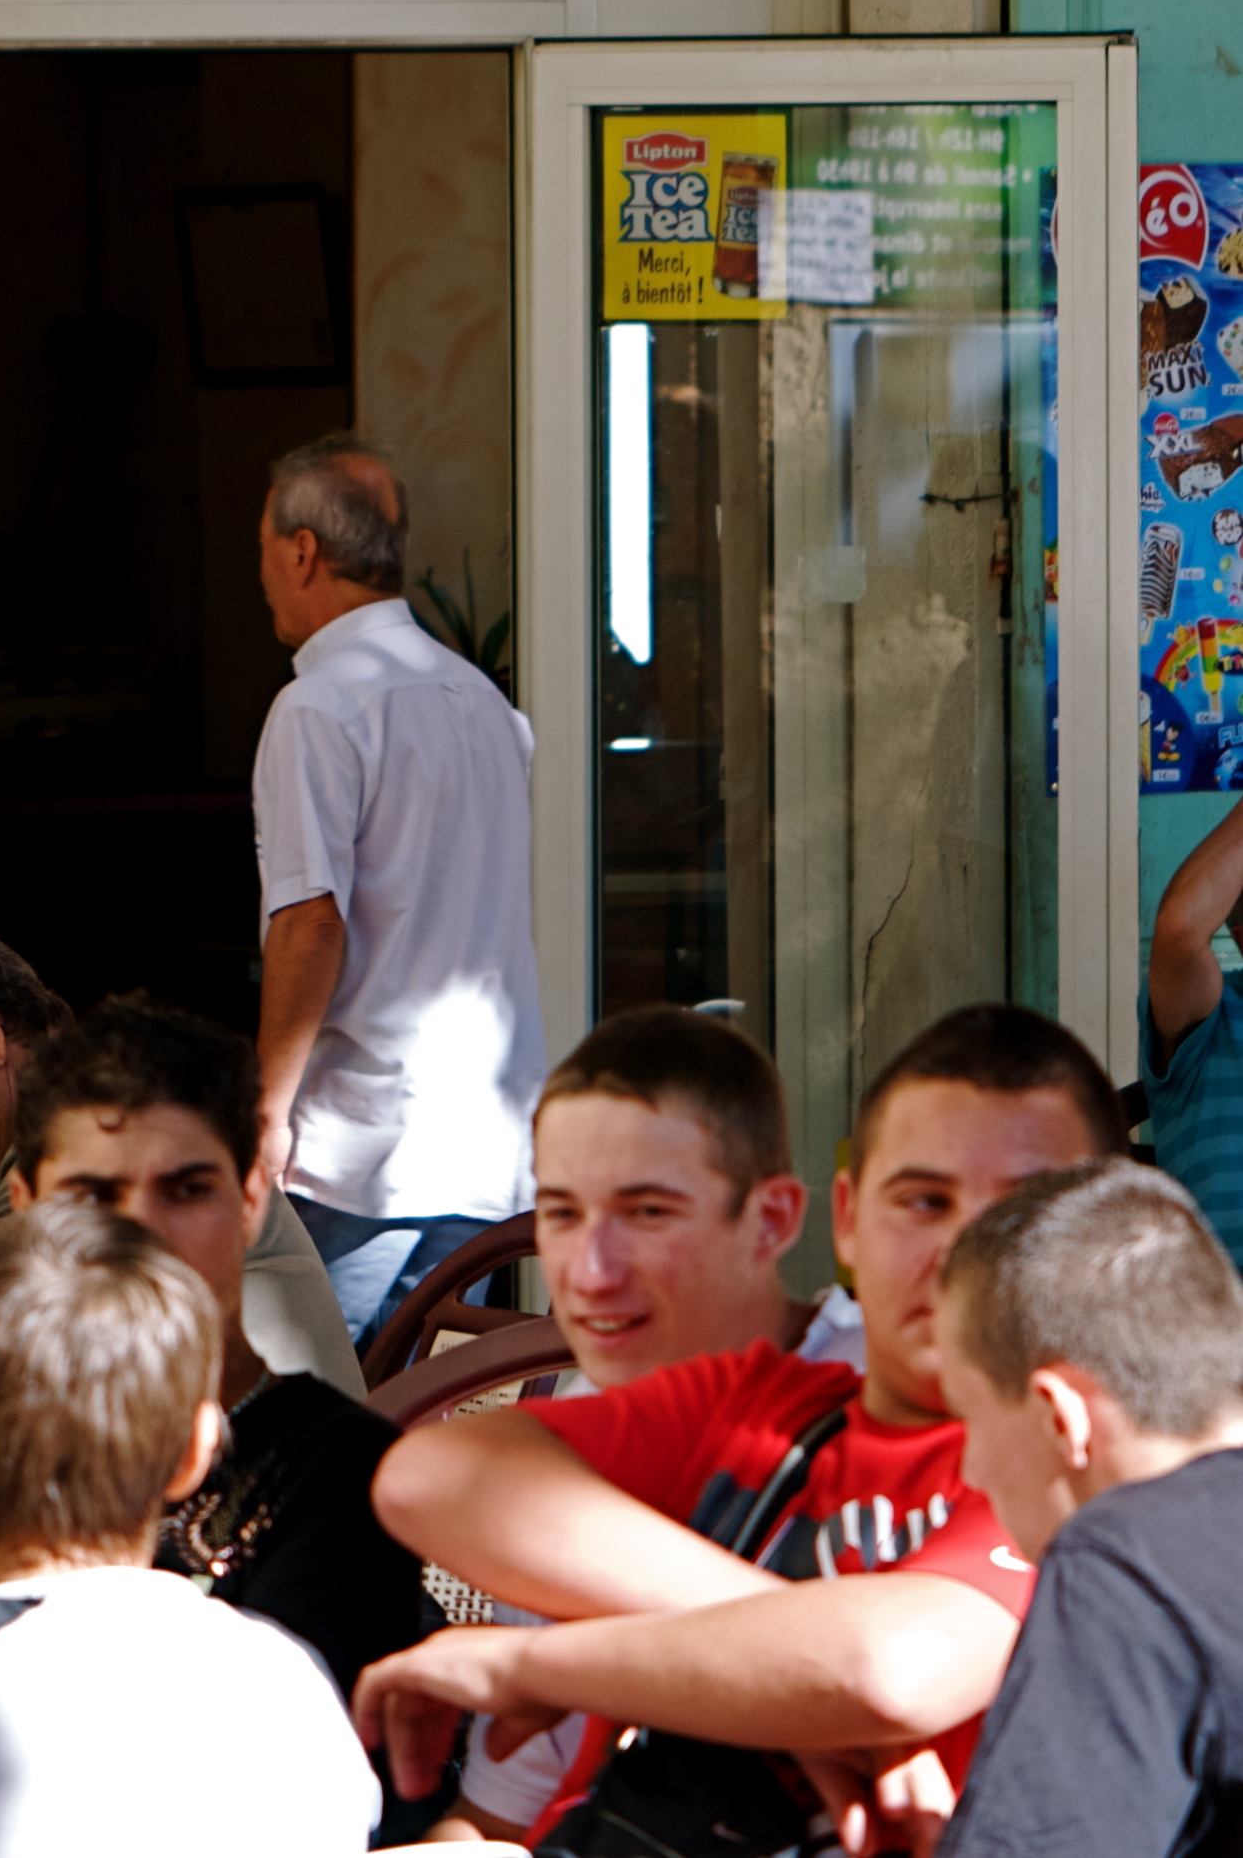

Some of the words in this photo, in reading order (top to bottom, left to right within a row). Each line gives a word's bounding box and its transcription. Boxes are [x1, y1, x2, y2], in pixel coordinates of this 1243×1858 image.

[633, 144, 698, 162] Lipton
[628, 173, 704, 208] Ice
[623, 206, 709, 241] Tea
[638, 247, 691, 276] Merci,
[622, 283, 631, 303] à
[637, 280, 692, 304] bientôt
[1149, 364, 1207, 396] SUN
[1143, 432, 1202, 460] XXL
